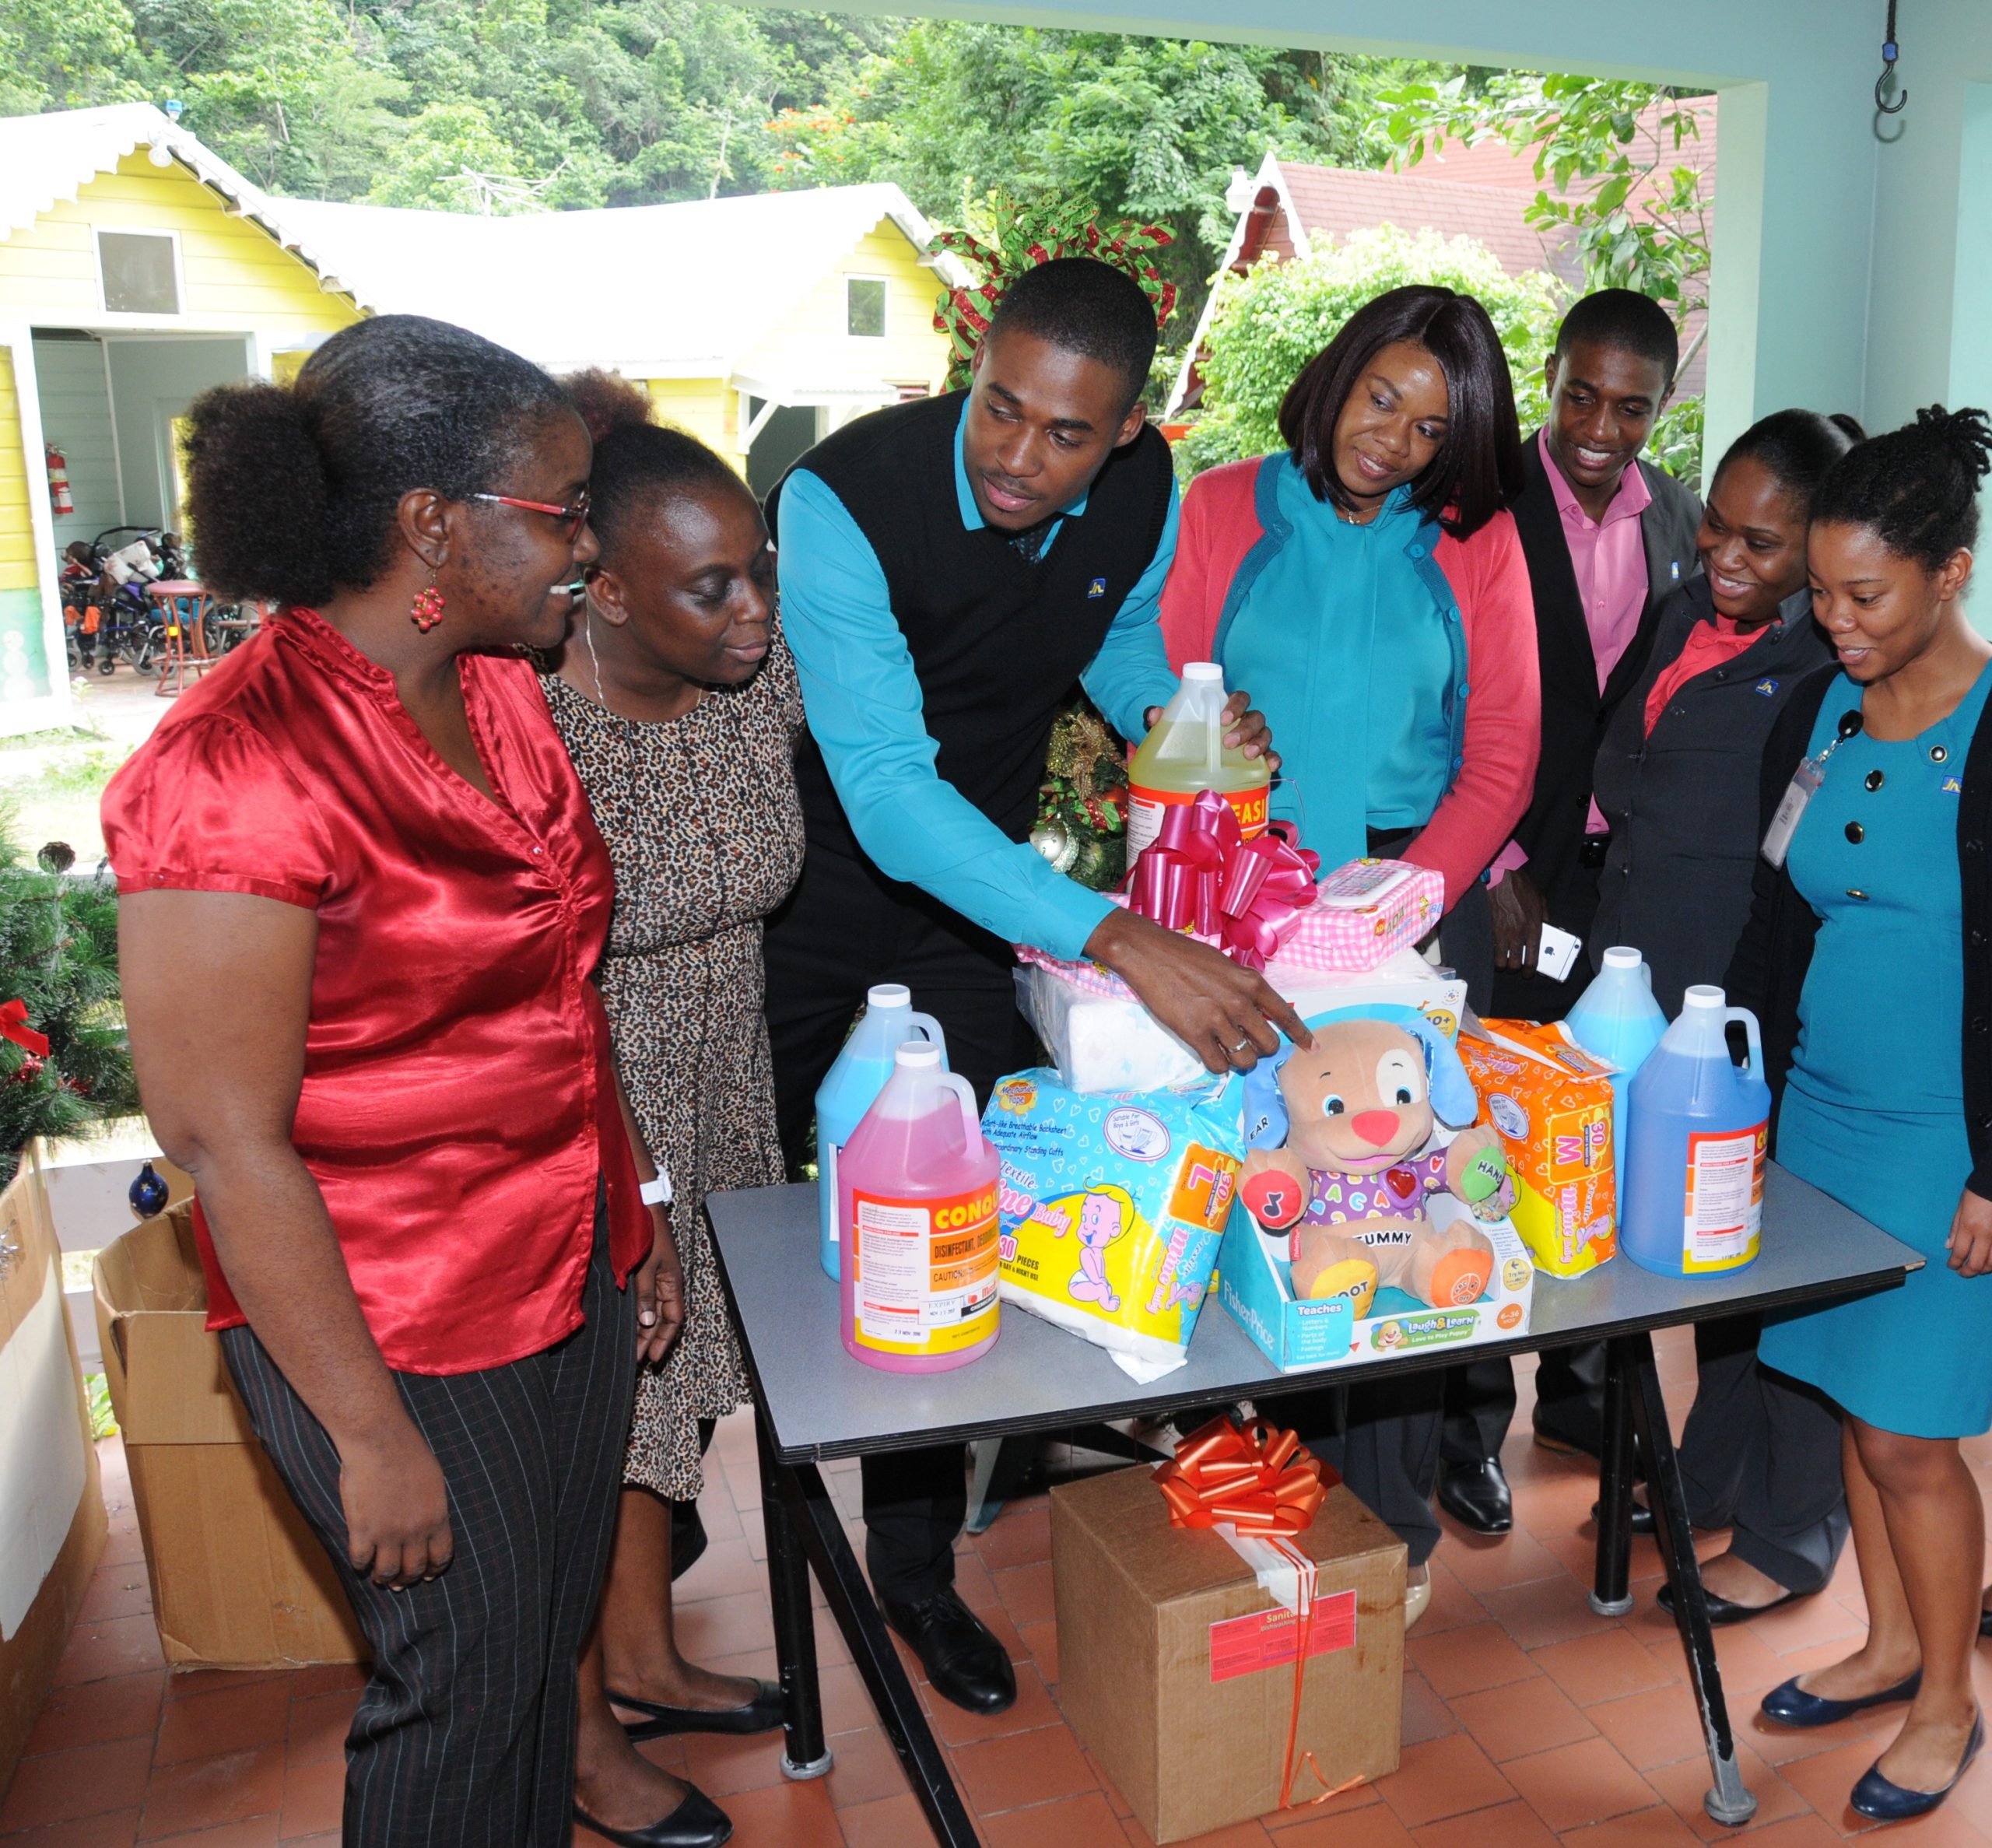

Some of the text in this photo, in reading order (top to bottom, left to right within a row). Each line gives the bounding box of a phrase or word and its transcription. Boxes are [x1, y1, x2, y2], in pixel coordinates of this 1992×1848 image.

[1008, 1094, 1025, 1106] Tape
[993, 1129, 1017, 1139] Adequate
[1019, 1131, 1038, 1140] Airflow
[1008, 1121, 1037, 1131] Breathable
[1039, 1124, 1067, 1134] Backsheet
[1250, 1117, 1268, 1141] EAR
[1591, 1122, 1605, 1145] 30
[1024, 1145, 1047, 1157] Standing
[1049, 1148, 1064, 1156] Cuffs
[1557, 1136, 1582, 1164] M
[1001, 1160, 1036, 1190] Textile
[1190, 1164, 1214, 1189] L
[1218, 1172, 1232, 1201] 30
[1030, 1202, 1072, 1238] Baby
[1355, 1232, 1412, 1245] UMMY
[1016, 1254, 1040, 1271] PIECES
[1015, 1268, 1029, 1278] NIGHT
[1030, 1272, 1039, 1281] USE
[1224, 1279, 1276, 1351] Fisher-Price
[1297, 1303, 1343, 1316] Teaches
